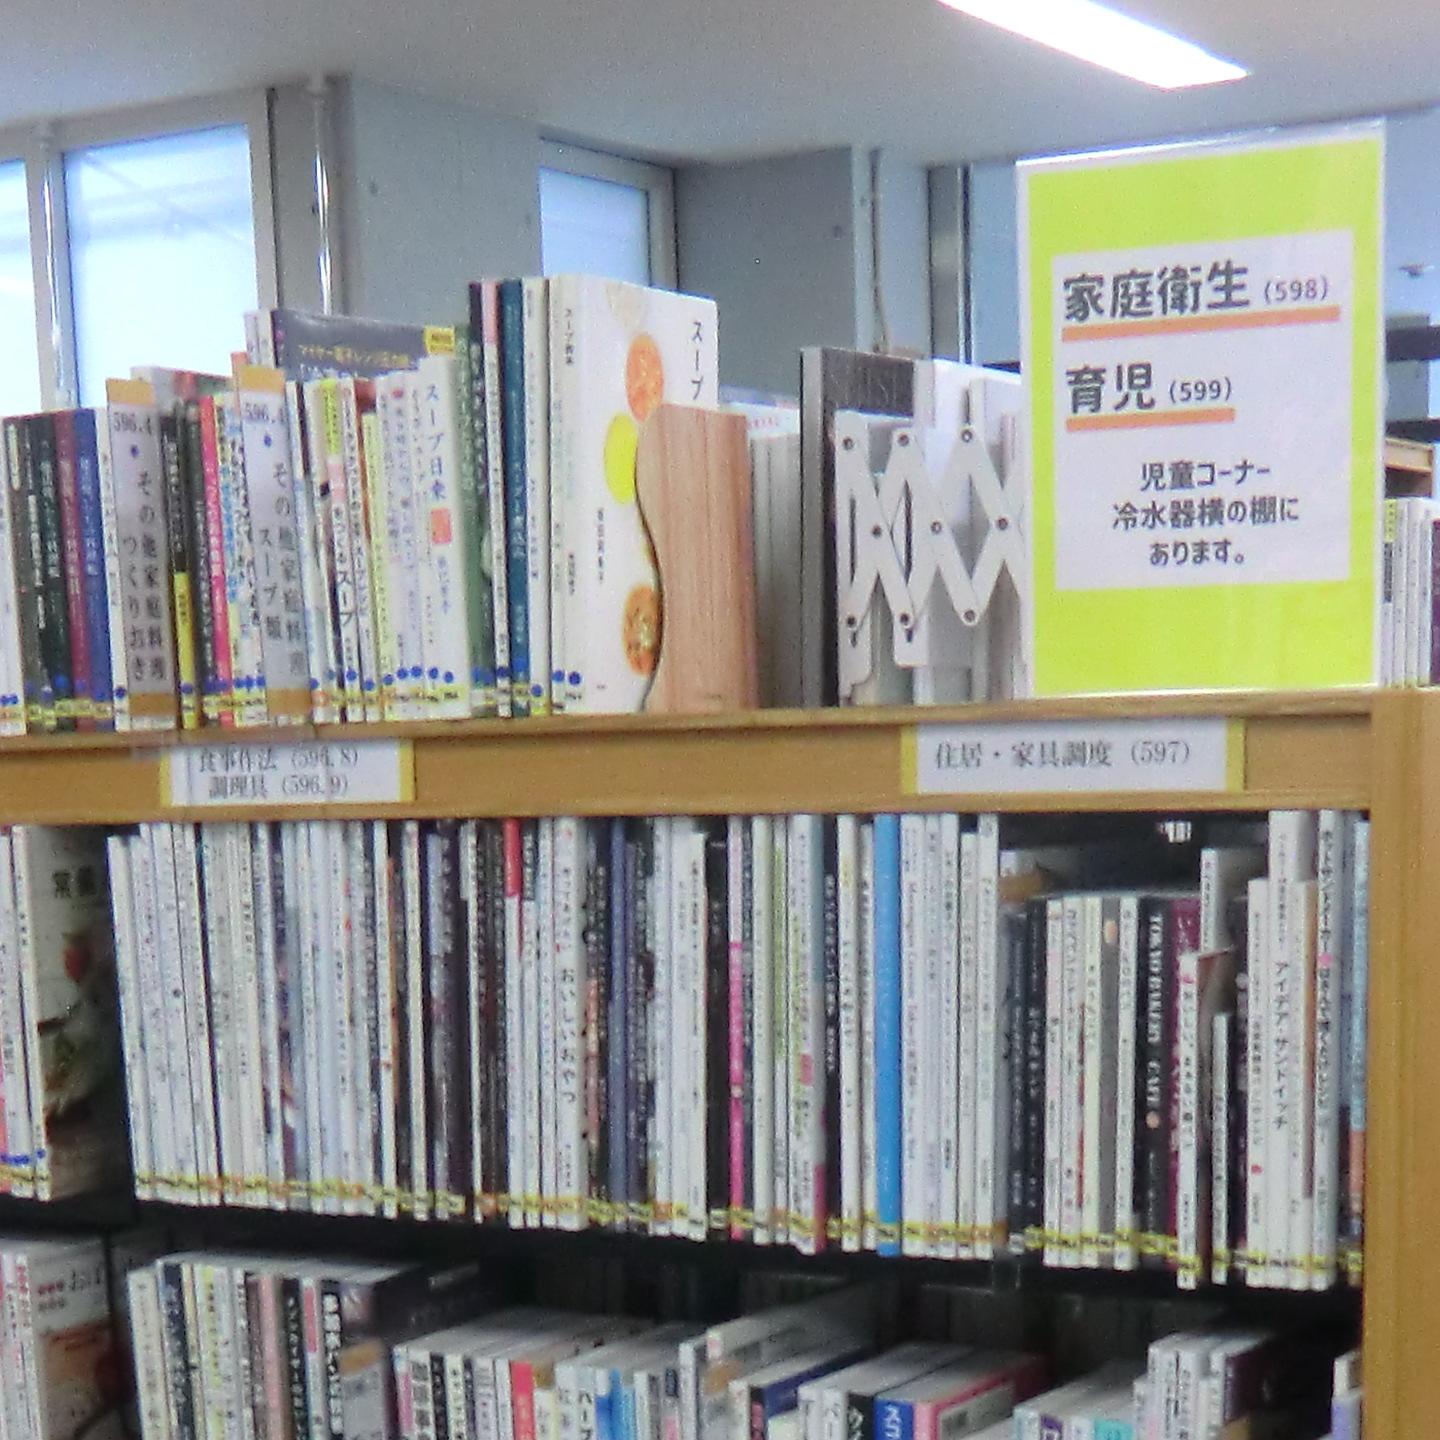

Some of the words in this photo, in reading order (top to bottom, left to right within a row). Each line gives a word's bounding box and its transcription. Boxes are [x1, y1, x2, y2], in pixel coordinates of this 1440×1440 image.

[1063, 258, 1250, 322] 家庭衛生
[1263, 276, 1330, 304] (598)
[690, 320, 706, 400] スープ
[1065, 361, 1156, 413] 育児
[1167, 376, 1234, 405] (599)
[1140, 460, 1272, 493] 児童コーナー
[1112, 495, 1300, 530] 冷水器横の棚に
[1148, 538, 1247, 567] あります。
[933, 740, 1113, 769] 住居・家具調度
[1130, 740, 1191, 766] (597)
[209, 774, 268, 799] 調理具
